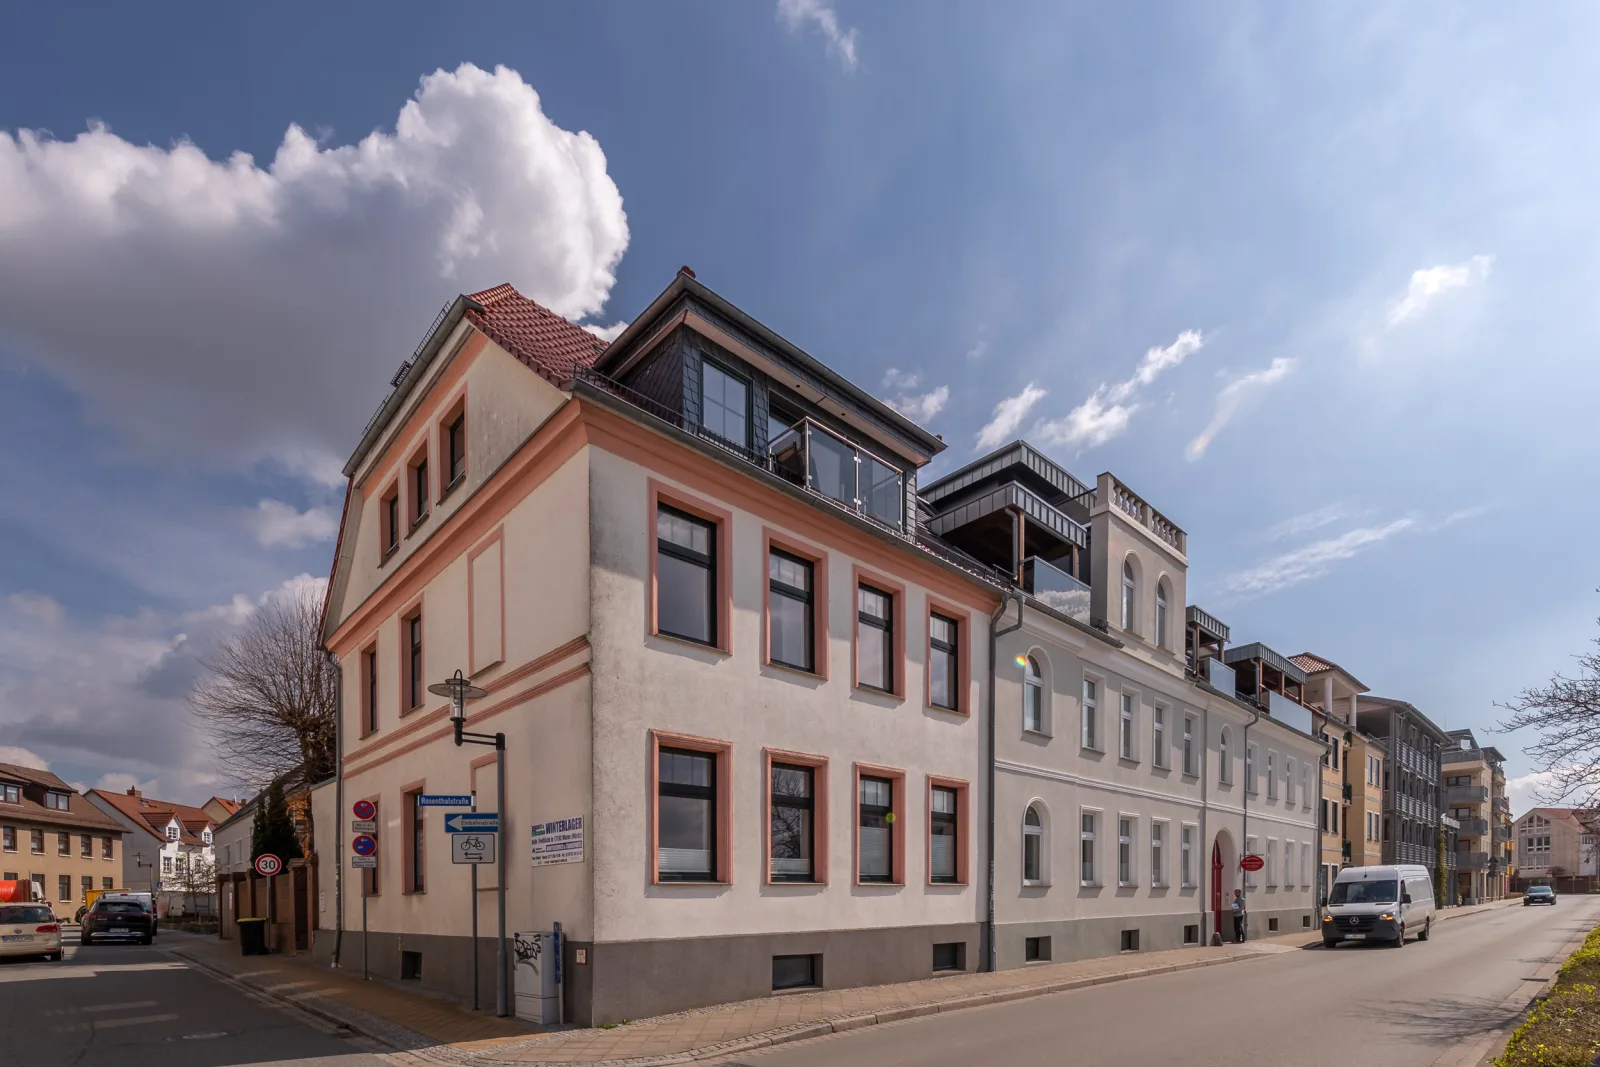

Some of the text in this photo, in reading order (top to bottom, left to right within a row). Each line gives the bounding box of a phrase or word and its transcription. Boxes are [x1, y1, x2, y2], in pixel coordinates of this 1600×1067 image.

[421, 797, 469, 805] Rosenthalstraße
[545, 817, 582, 835] WINTERLAGER
[261, 860, 276, 870] 30
